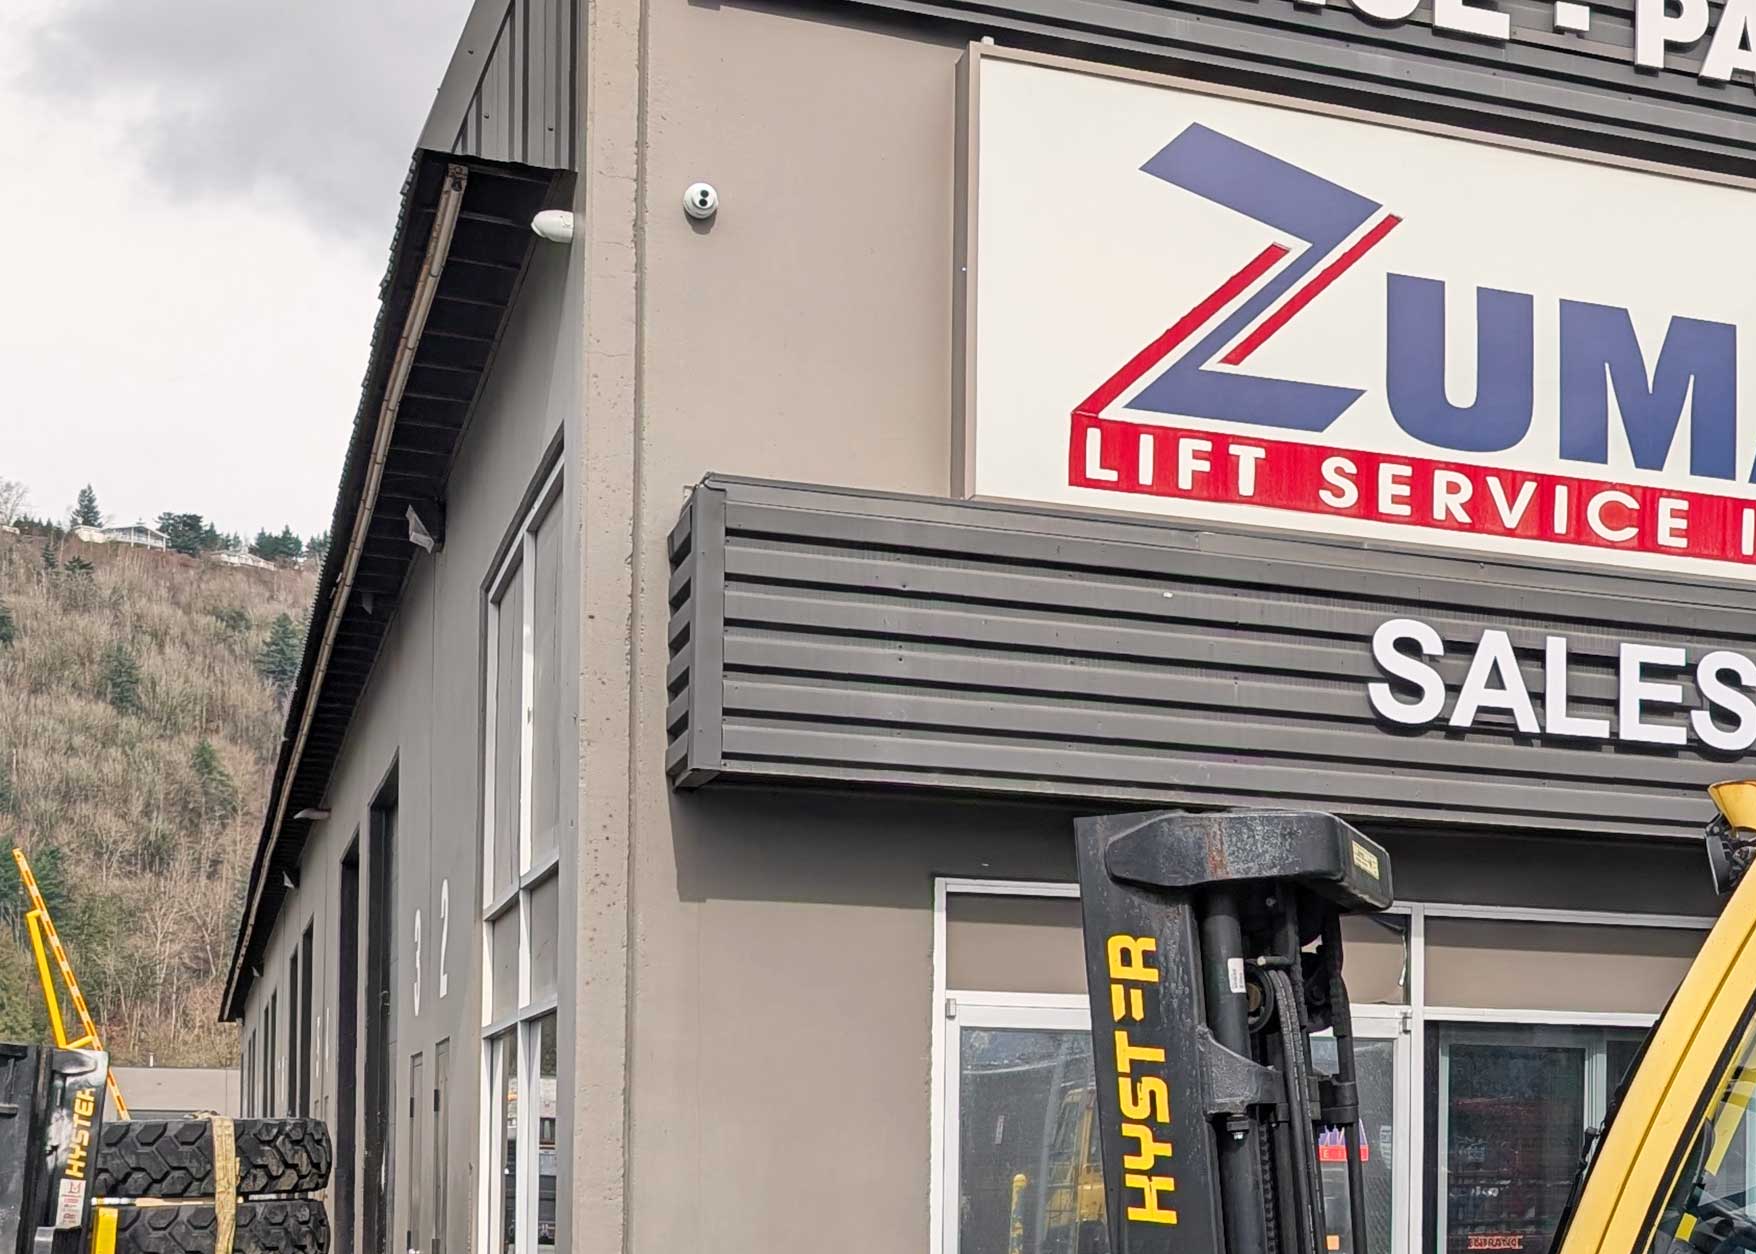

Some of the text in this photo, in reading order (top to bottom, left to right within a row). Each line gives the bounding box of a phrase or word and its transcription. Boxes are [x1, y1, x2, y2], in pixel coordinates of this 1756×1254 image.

[1084, 427, 1268, 497] LIFT
[1320, 456, 1690, 549] SERVICE
[413, 908, 422, 1017] 3
[440, 878, 449, 999] 2
